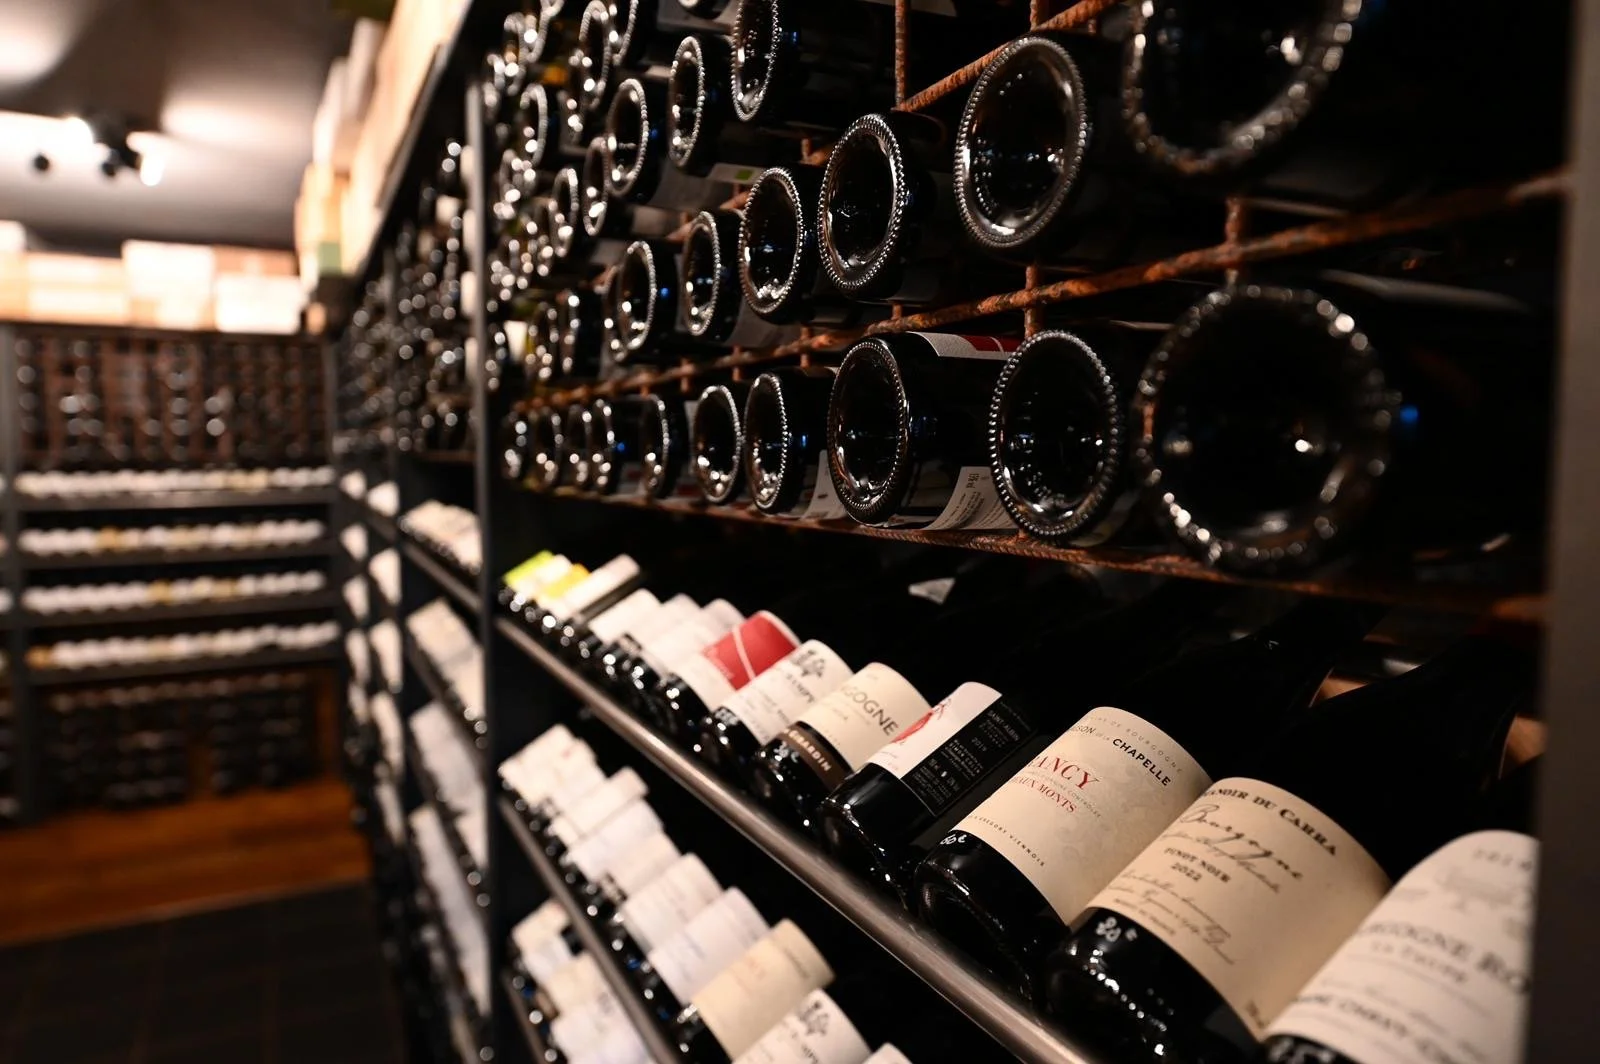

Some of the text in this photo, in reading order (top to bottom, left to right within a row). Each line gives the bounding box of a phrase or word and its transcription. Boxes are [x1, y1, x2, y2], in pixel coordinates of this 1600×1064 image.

[1112, 738, 1172, 787] CHAPELLE
[1038, 782, 1077, 814] MONTS
[1253, 796, 1278, 810] DU
[1163, 846, 1232, 884] PINOT NOIR
[1171, 860, 1203, 882] 2022
